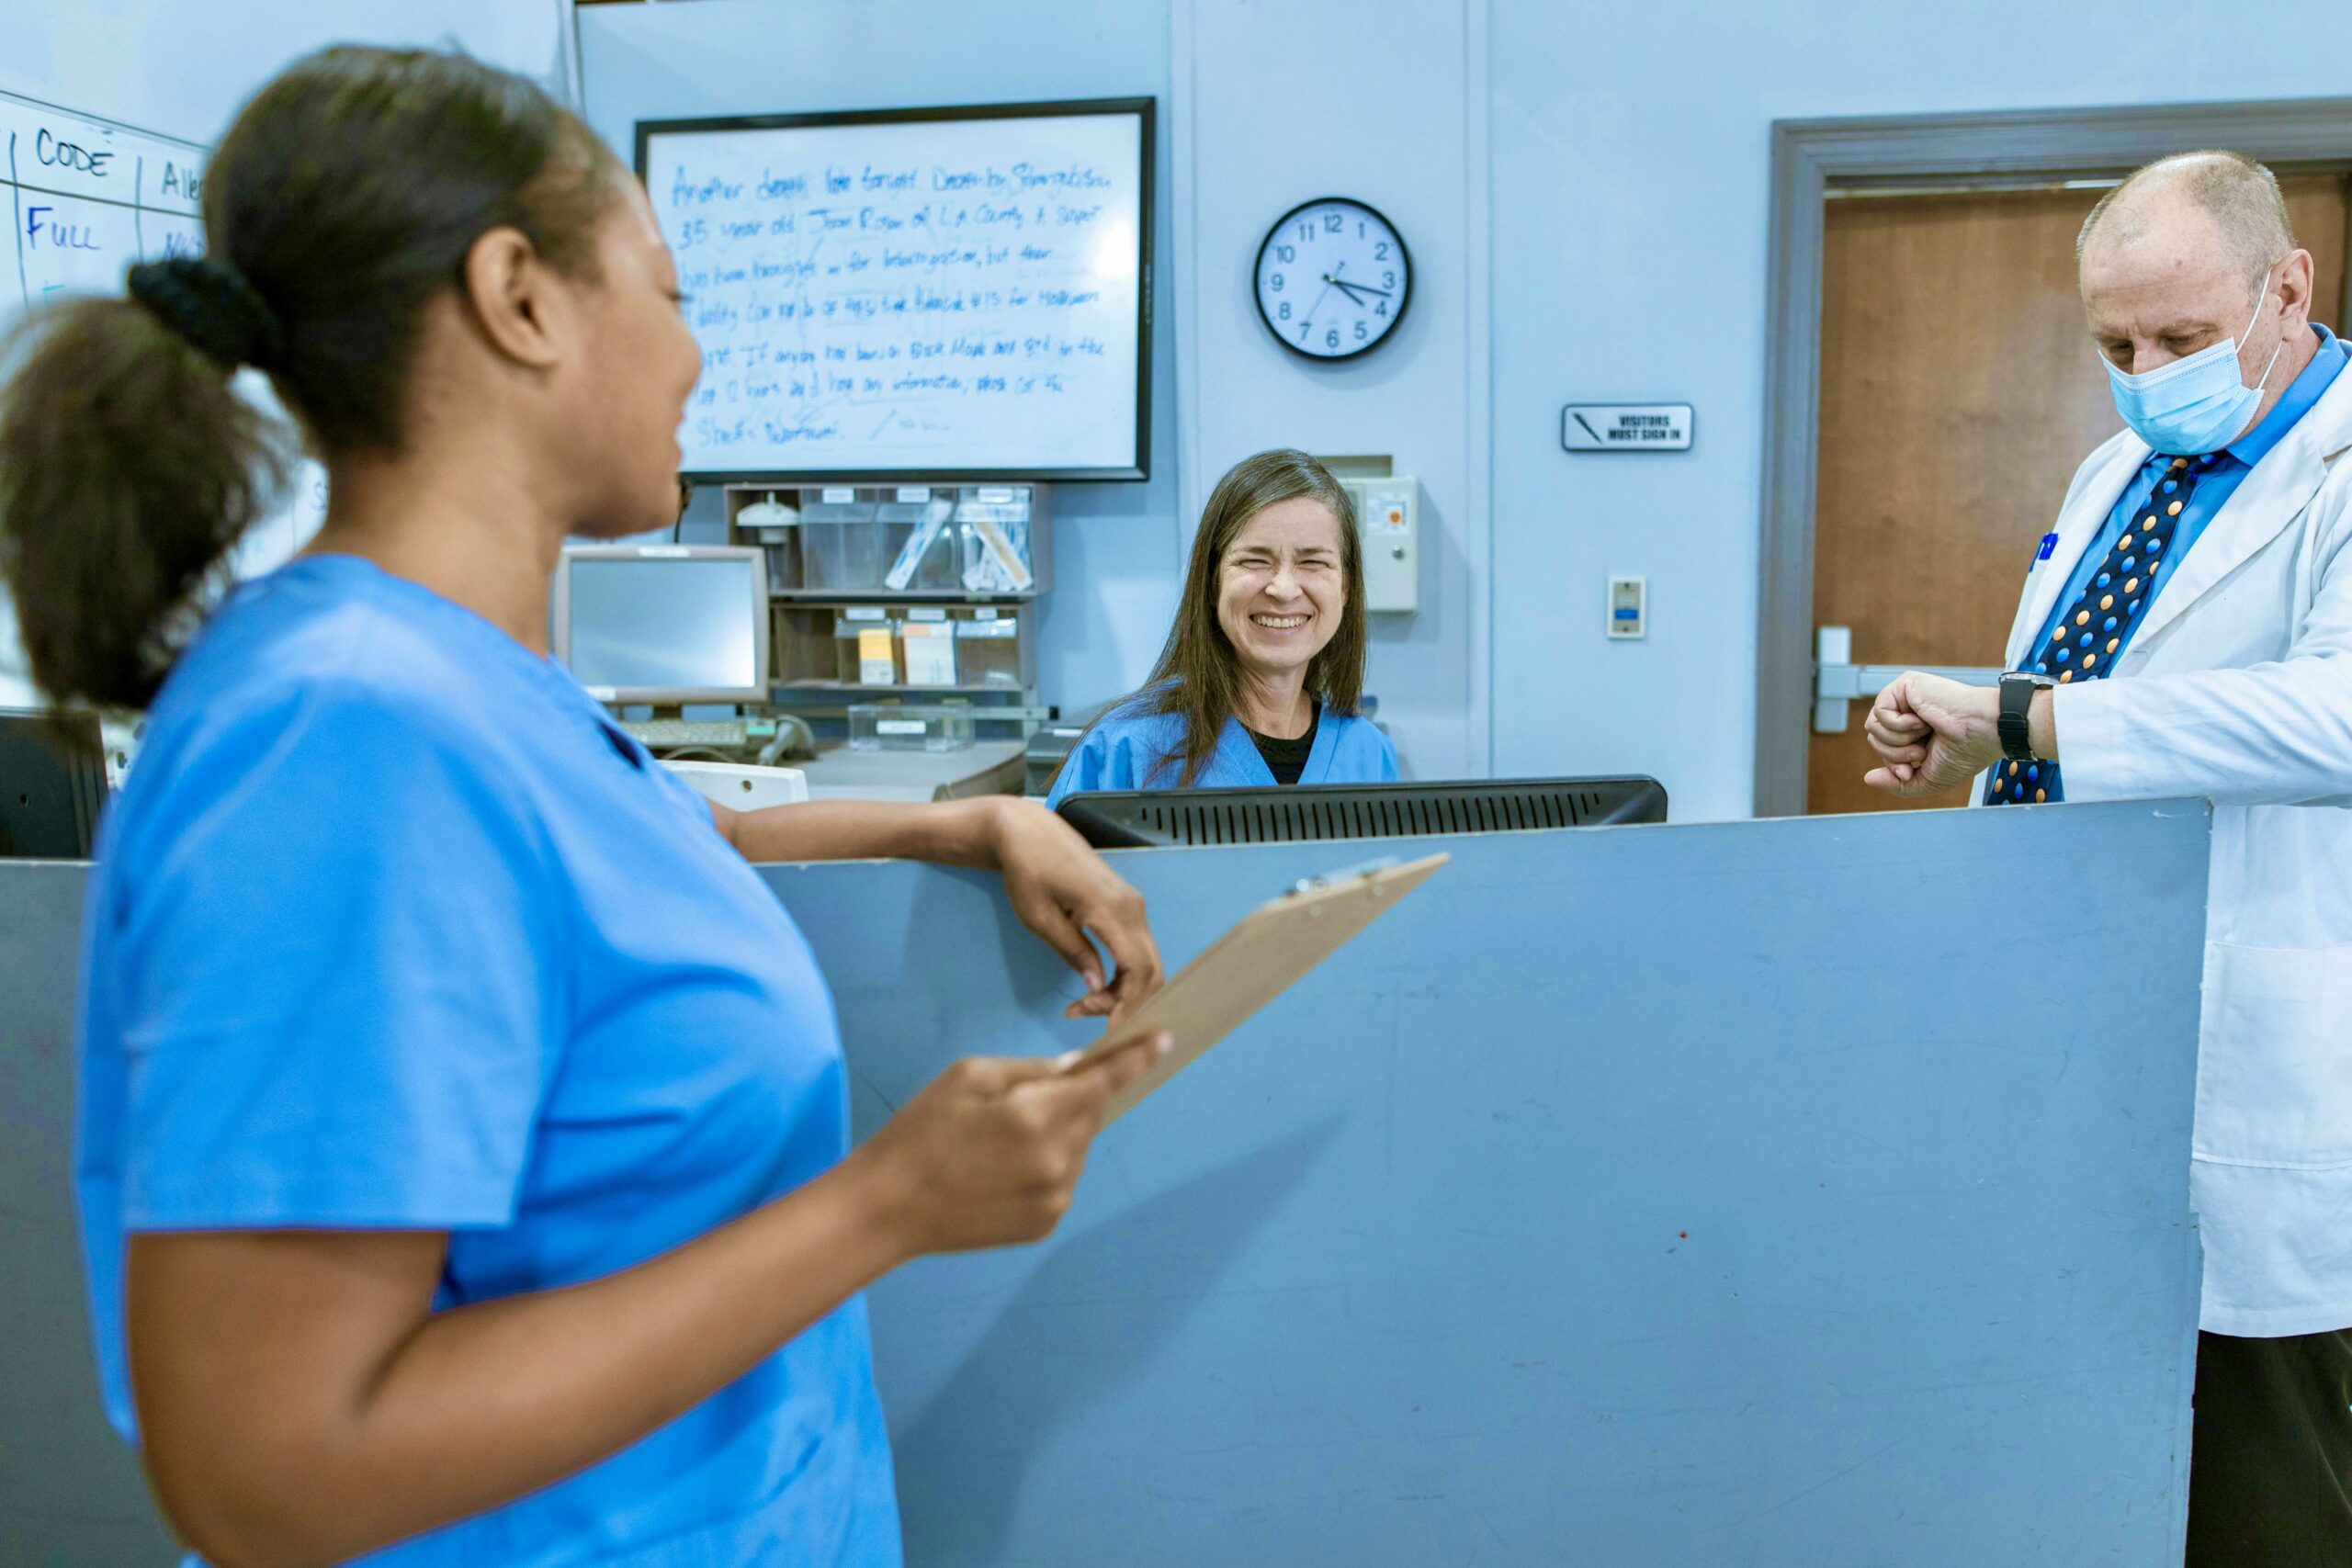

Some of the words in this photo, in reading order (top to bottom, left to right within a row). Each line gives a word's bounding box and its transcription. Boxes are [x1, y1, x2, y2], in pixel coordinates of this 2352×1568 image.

[37, 127, 115, 176] CODE
[1298, 223, 1315, 243] 11
[1323, 214, 1343, 233] 12
[1358, 221, 1365, 241] 1
[676, 217, 707, 251] 35
[1276, 244, 1296, 265] 10
[1374, 242, 1389, 261] 2
[1270, 274, 1284, 293] 9
[1382, 270, 1396, 290] 3
[1278, 301, 1292, 321] 8
[1374, 299, 1387, 319] 4
[1299, 321, 1312, 341] 7
[1326, 329, 1340, 348] 6
[1353, 321, 1367, 340] 5
[1618, 414, 1670, 427] VISITORS
[1608, 428, 1639, 441] MUST
[1641, 428, 1667, 441] SIGN
[1669, 428, 1681, 440] IN
